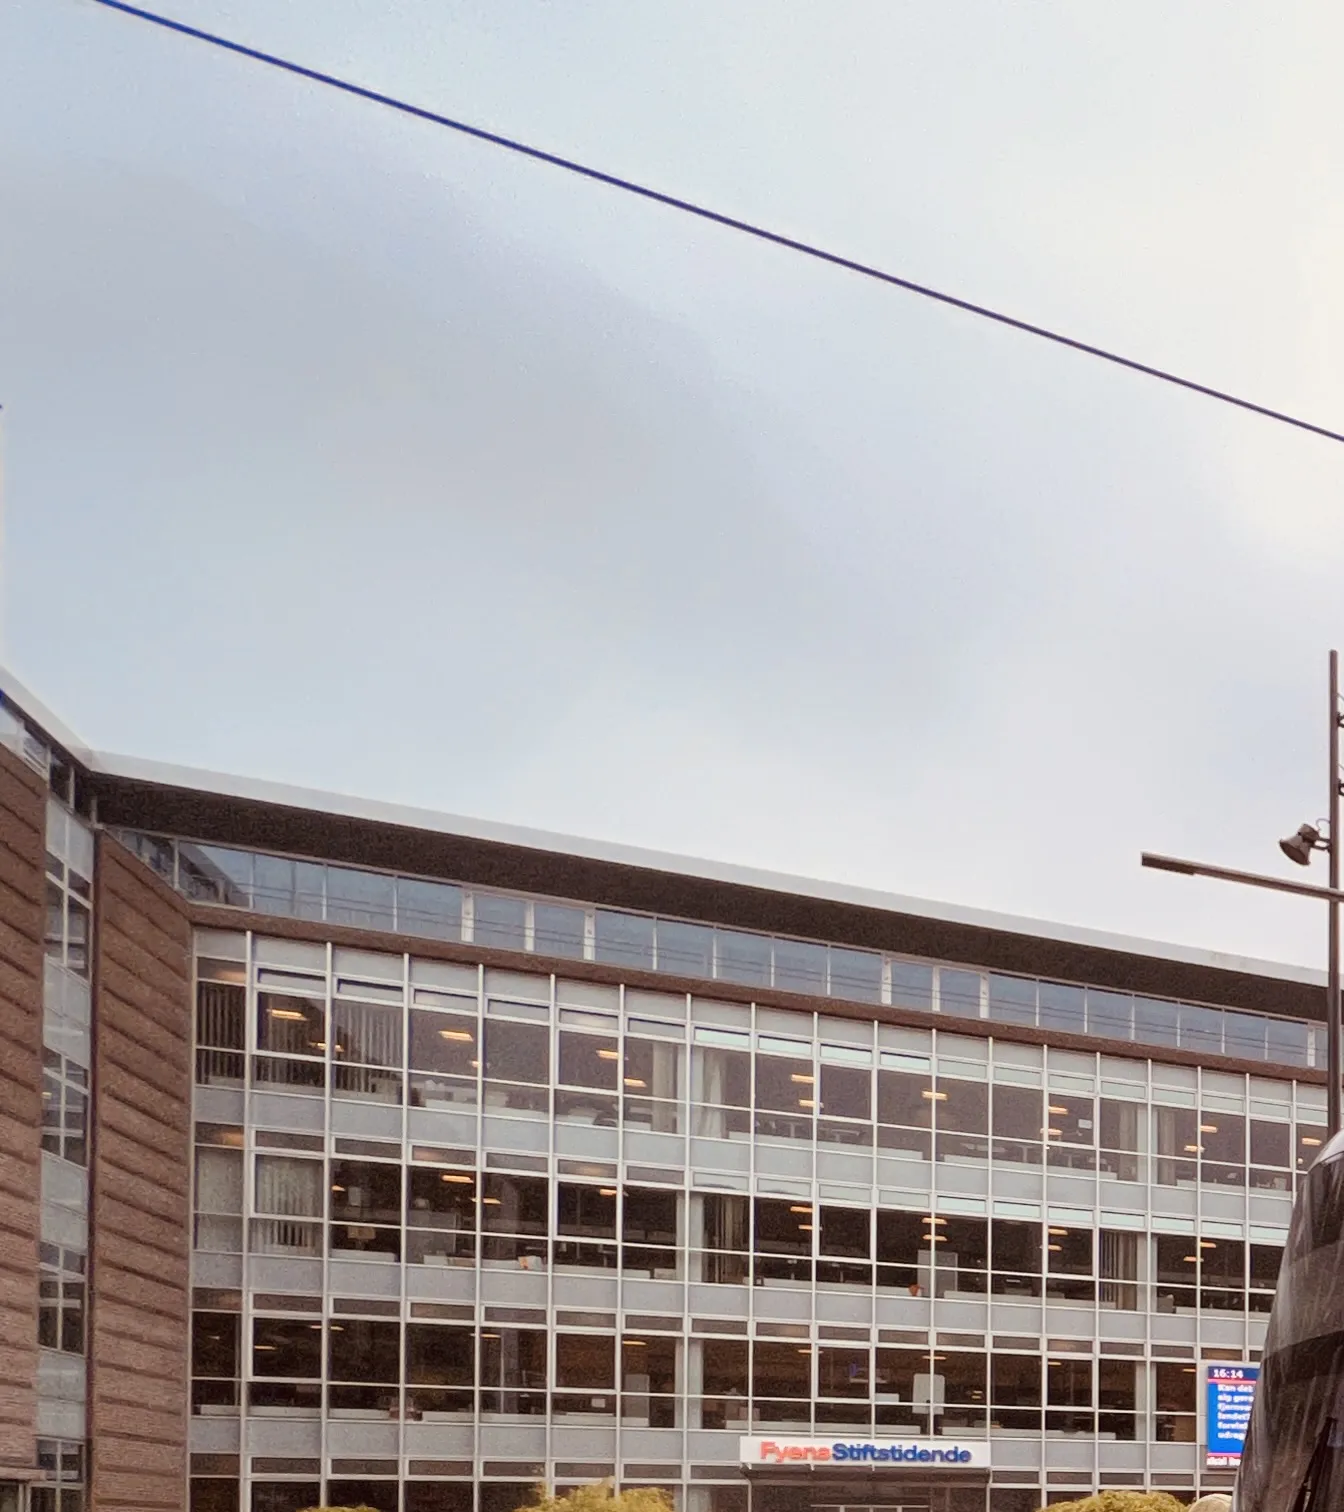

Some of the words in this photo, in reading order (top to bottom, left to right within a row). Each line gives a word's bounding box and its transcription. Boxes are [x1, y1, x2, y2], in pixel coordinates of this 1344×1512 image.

[1213, 1368, 1244, 1378] 16:14
[760, 1441, 830, 1463] Fyens
[832, 1443, 972, 1463] Stiftstidende
